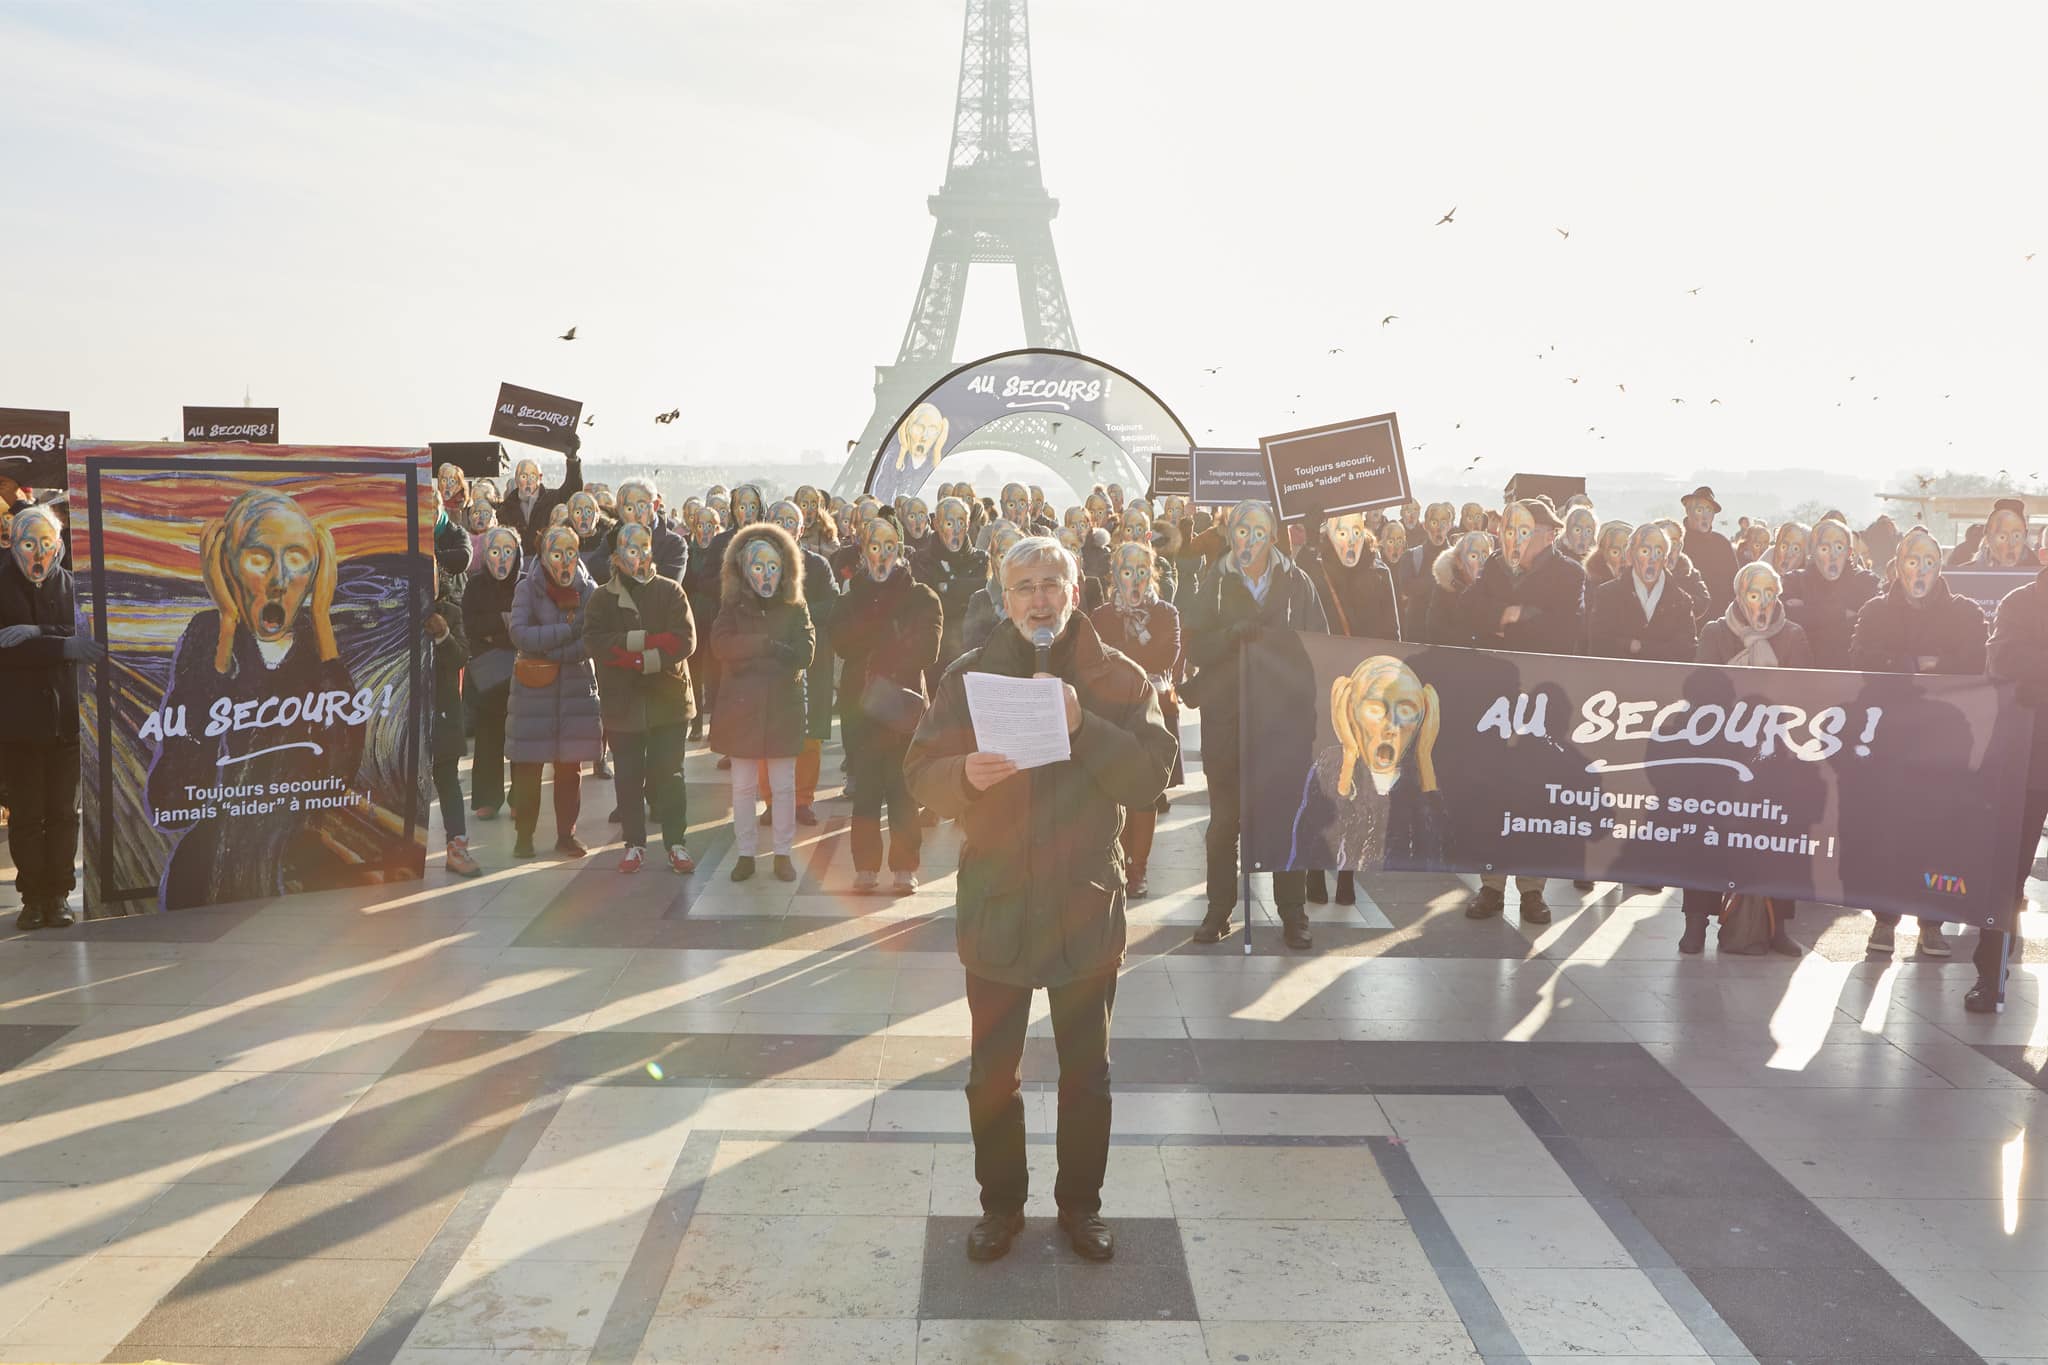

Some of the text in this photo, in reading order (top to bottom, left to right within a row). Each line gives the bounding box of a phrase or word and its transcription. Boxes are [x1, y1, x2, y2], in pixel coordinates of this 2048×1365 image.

[968, 376, 996, 394] AU
[1002, 376, 1100, 401] SECOURS
[499, 403, 514, 414] AU
[517, 406, 569, 427] SECOURS
[0, 434, 55, 452] COURS
[188, 426, 204, 437] AU
[209, 424, 267, 437] SECOURS
[1295, 455, 1375, 477] Toujours secourir,
[1283, 481, 1314, 494] jamais
[1348, 472, 1355, 481] à
[1356, 467, 1386, 479] mourir
[138, 704, 187, 741] AU
[204, 687, 374, 737] SECOURS
[1477, 692, 1548, 739] AU
[1571, 690, 1846, 763] SECOURS
[185, 775, 346, 802] Toujours secourir,
[153, 804, 217, 827] jamais
[289, 797, 300, 811] à
[305, 792, 362, 811] mourir
[1545, 783, 1789, 825] Toujours secourir,
[1501, 811, 1593, 837] jamais
[1703, 825, 1719, 846] à
[1727, 831, 1820, 856] mourir
[1924, 872, 1967, 895] VITA
